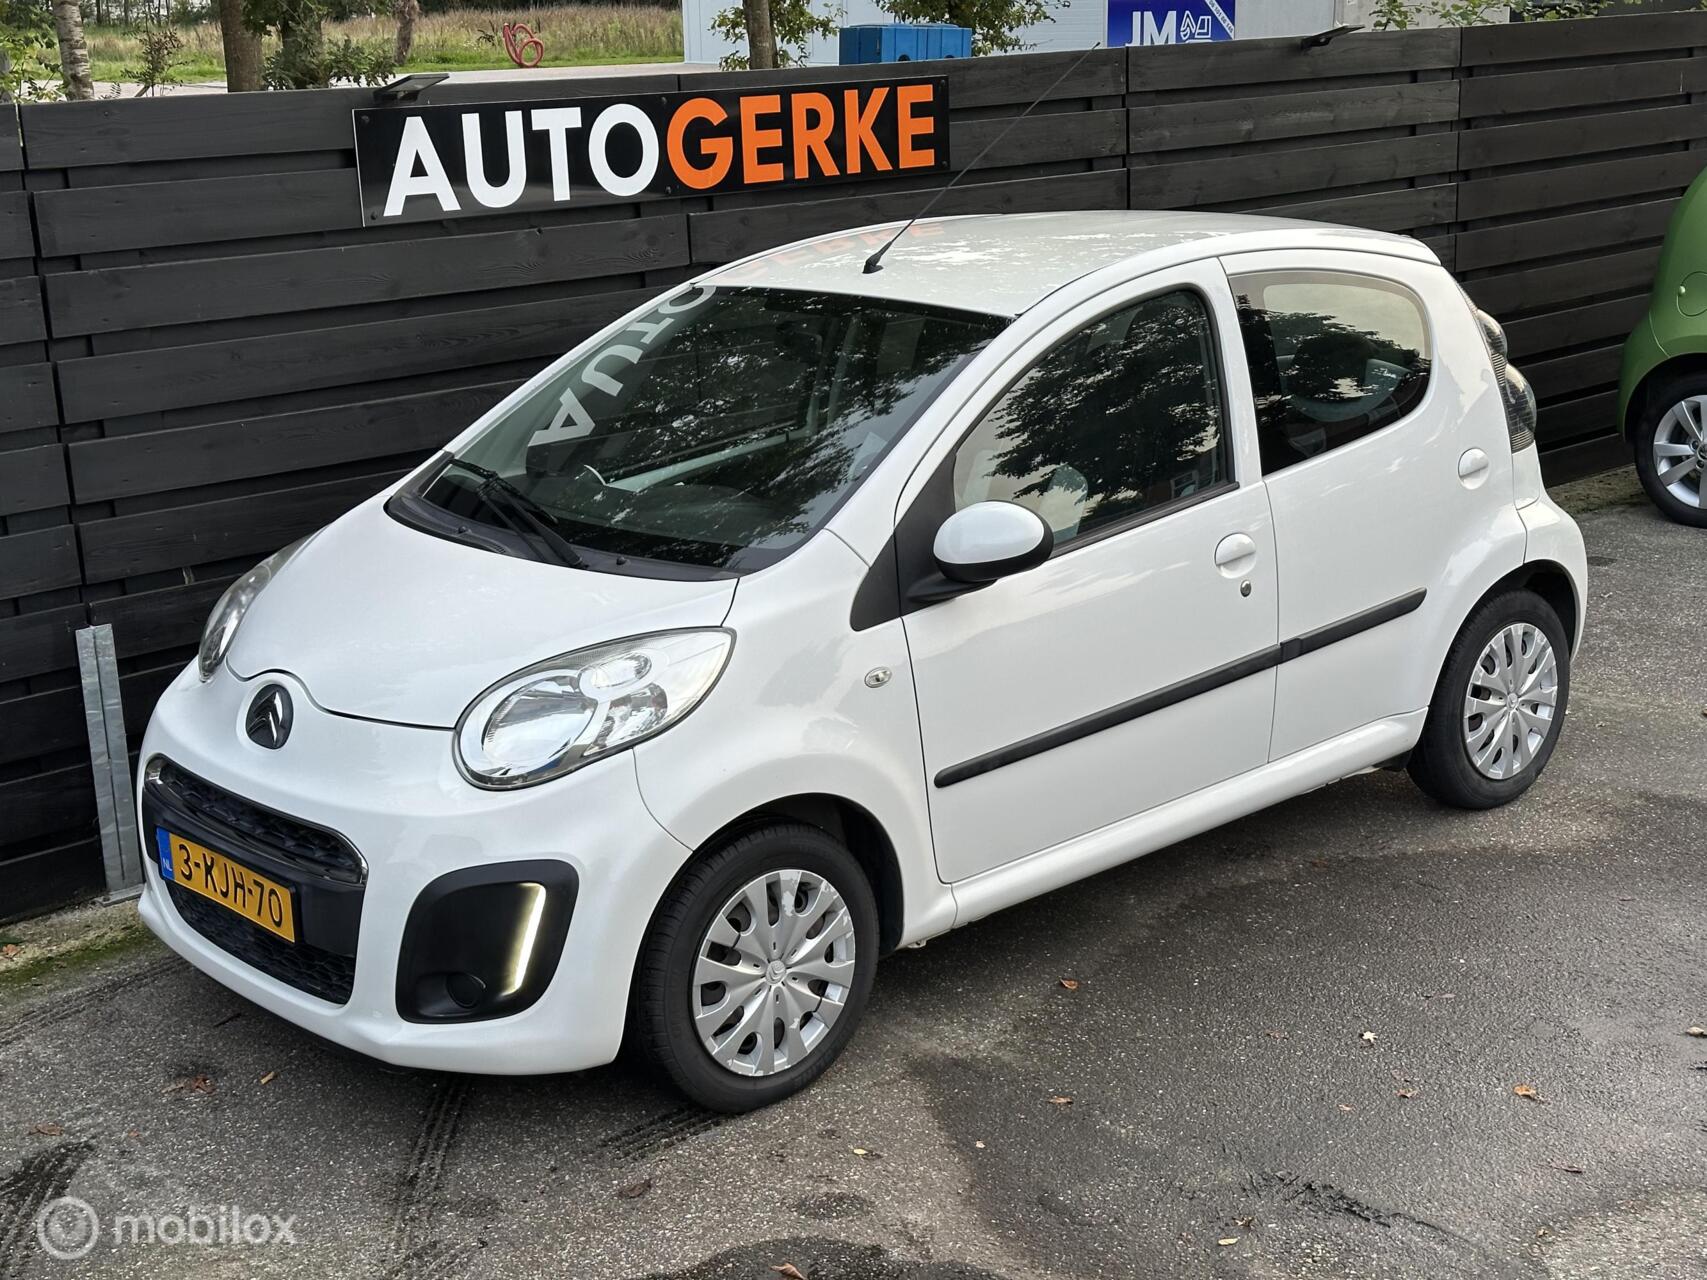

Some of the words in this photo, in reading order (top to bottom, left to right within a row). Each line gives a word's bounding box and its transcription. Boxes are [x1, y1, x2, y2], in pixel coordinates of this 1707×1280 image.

[1125, 10, 1177, 47] JM
[162, 857, 173, 872] NL
[178, 843, 283, 928] 3-KJH-70
